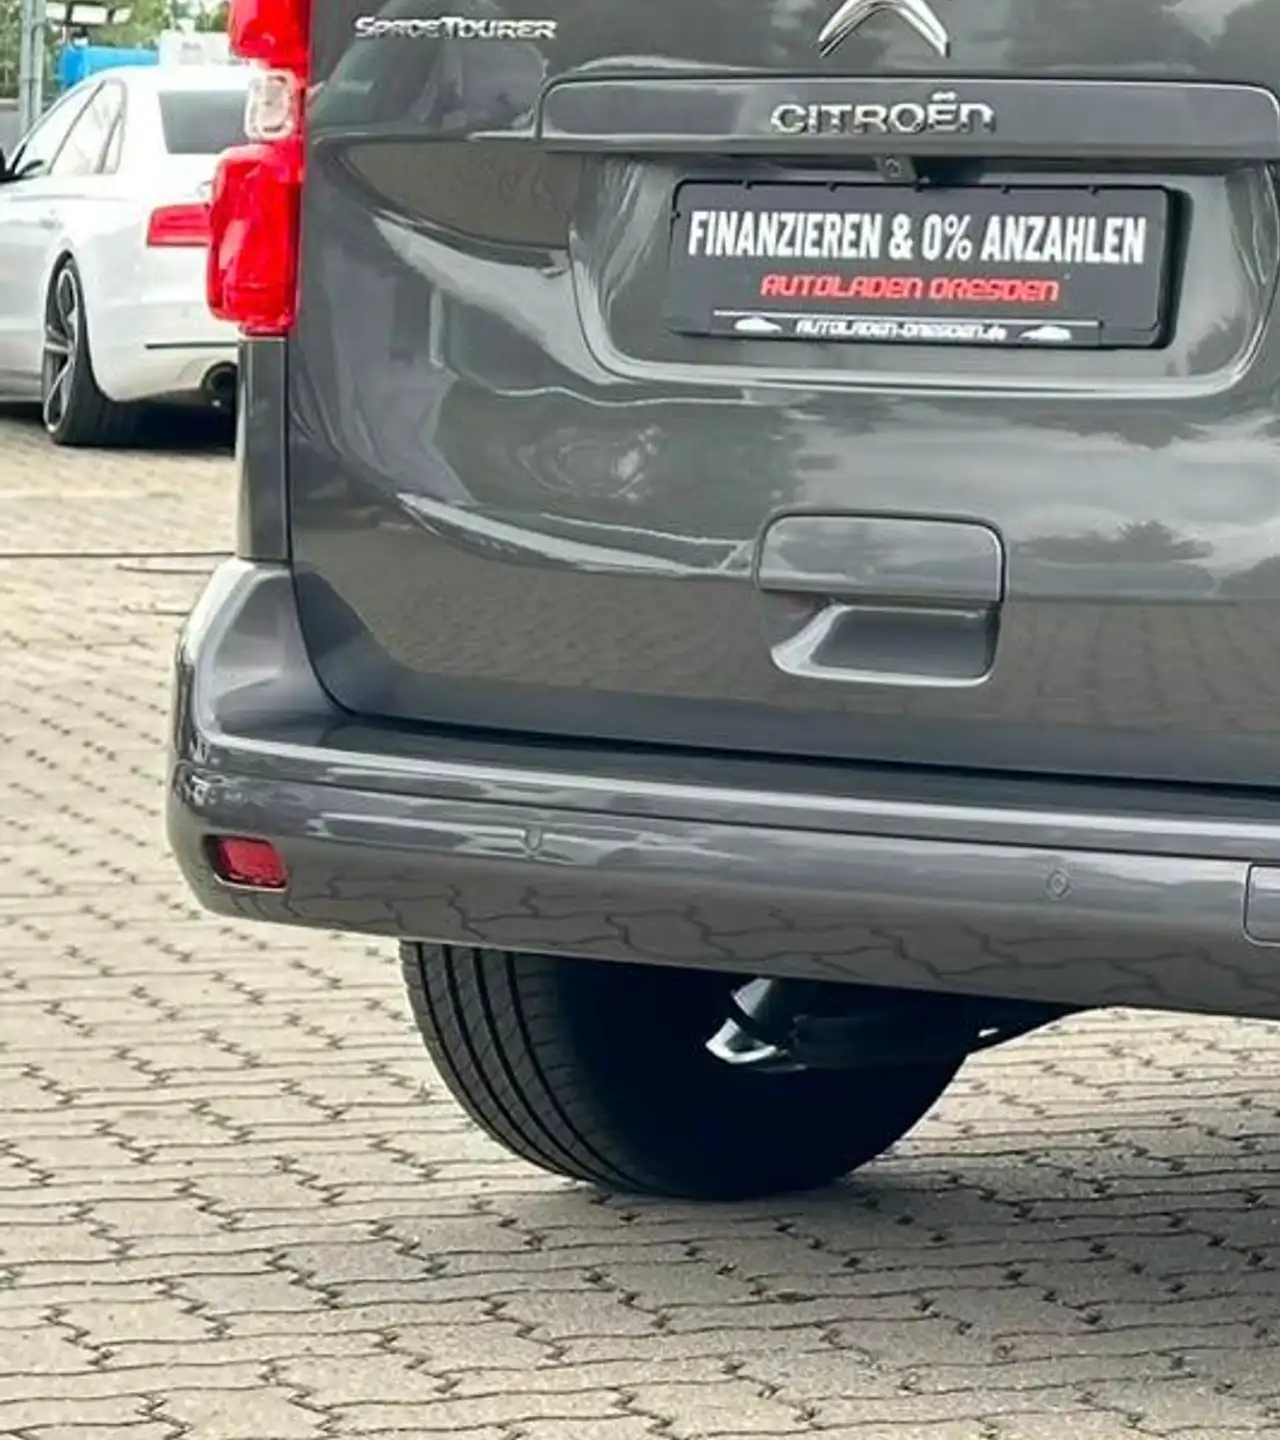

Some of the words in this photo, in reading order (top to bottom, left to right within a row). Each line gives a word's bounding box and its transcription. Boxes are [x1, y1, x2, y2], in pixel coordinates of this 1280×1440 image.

[770, 90, 995, 134] CITROËN
[688, 210, 882, 258] FINANZIEREN
[888, 213, 914, 260] &
[921, 213, 973, 261] 0%
[980, 215, 1147, 264] ANZAHLEN
[760, 274, 922, 298] AUTOLADEN
[928, 277, 1060, 302] DRESDEN
